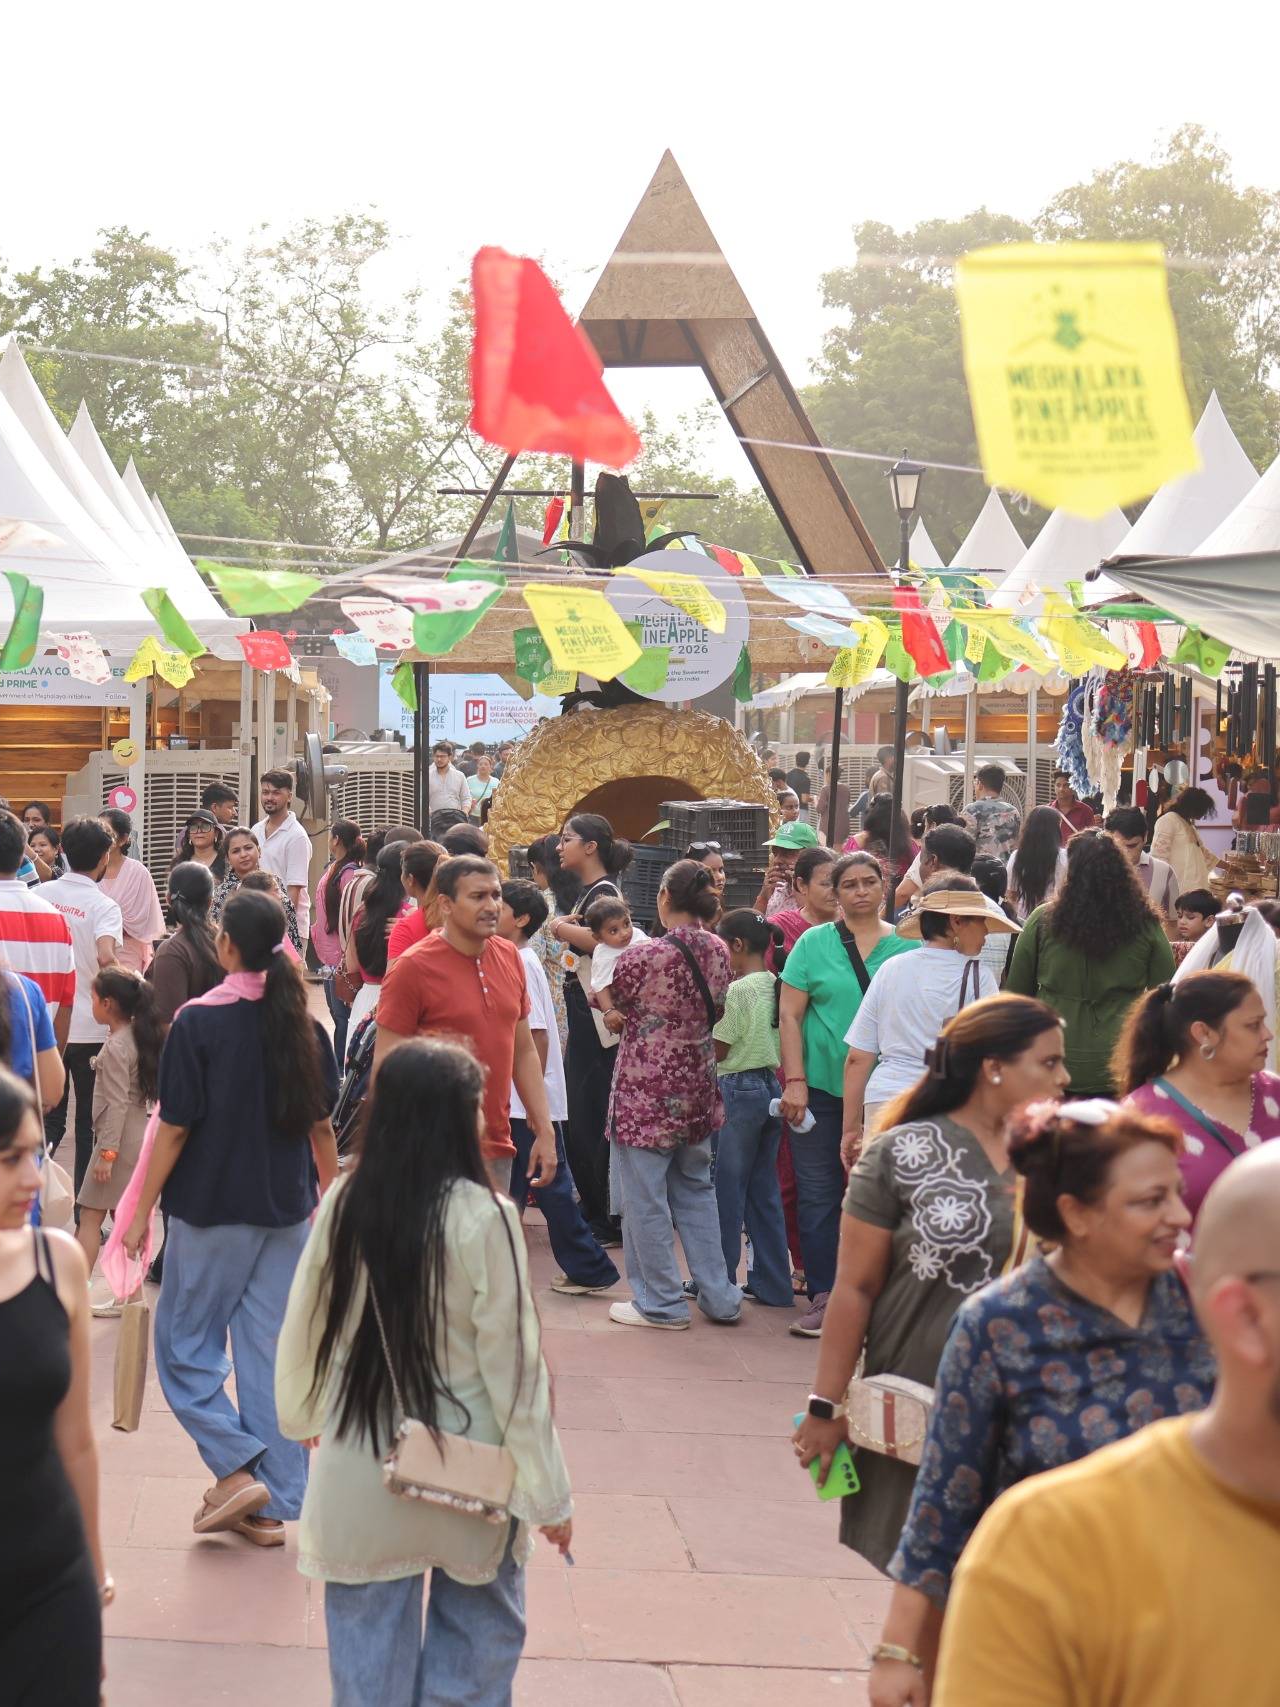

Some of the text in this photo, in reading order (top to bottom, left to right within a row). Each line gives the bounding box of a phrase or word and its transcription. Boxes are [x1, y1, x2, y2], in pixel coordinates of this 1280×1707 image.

[643, 621, 709, 644] INEAPPLE
[678, 645, 708, 655] 2026
[6, 680, 38, 689] PRIME
